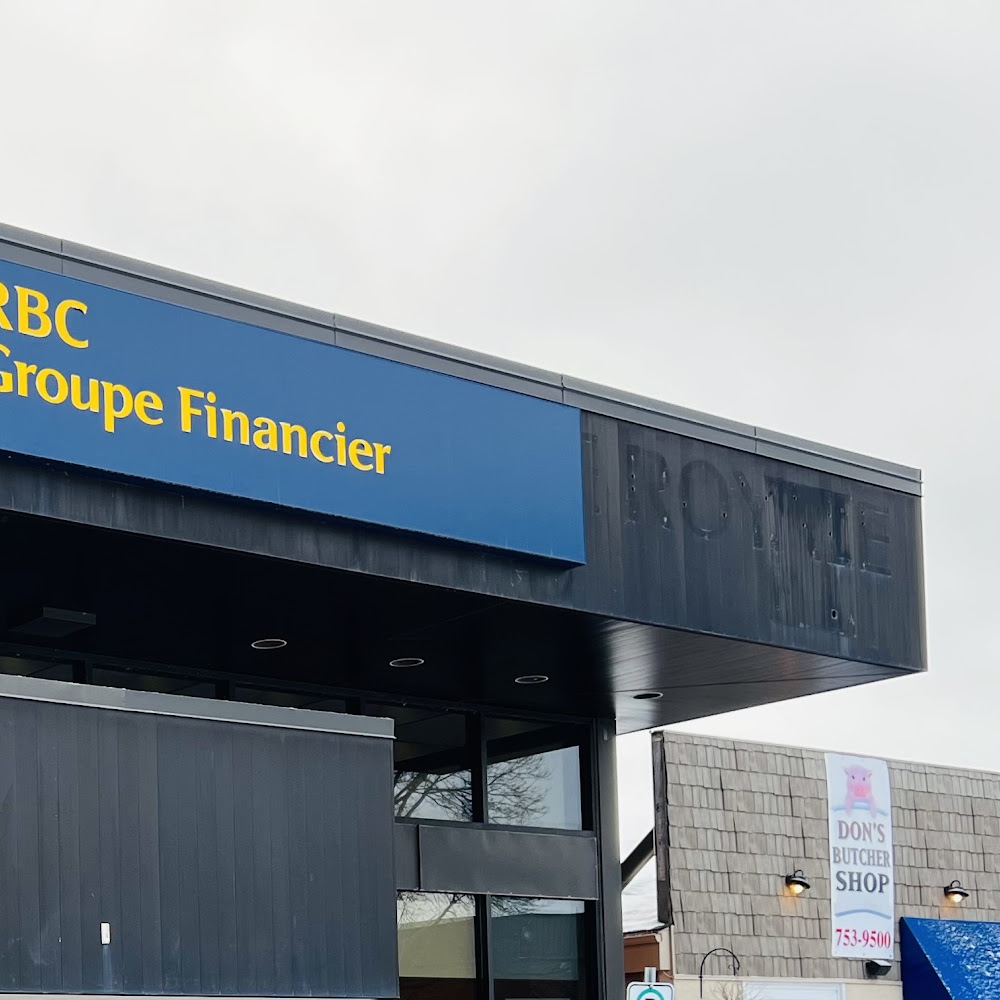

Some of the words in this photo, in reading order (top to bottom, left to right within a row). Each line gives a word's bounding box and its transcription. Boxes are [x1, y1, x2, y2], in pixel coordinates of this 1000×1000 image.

[177, 386, 392, 474] Financier
[837, 819, 886, 843] DON'S
[832, 846, 891, 868] BUTCHER
[835, 870, 890, 893] SHOP
[835, 928, 891, 949] 753-9500
